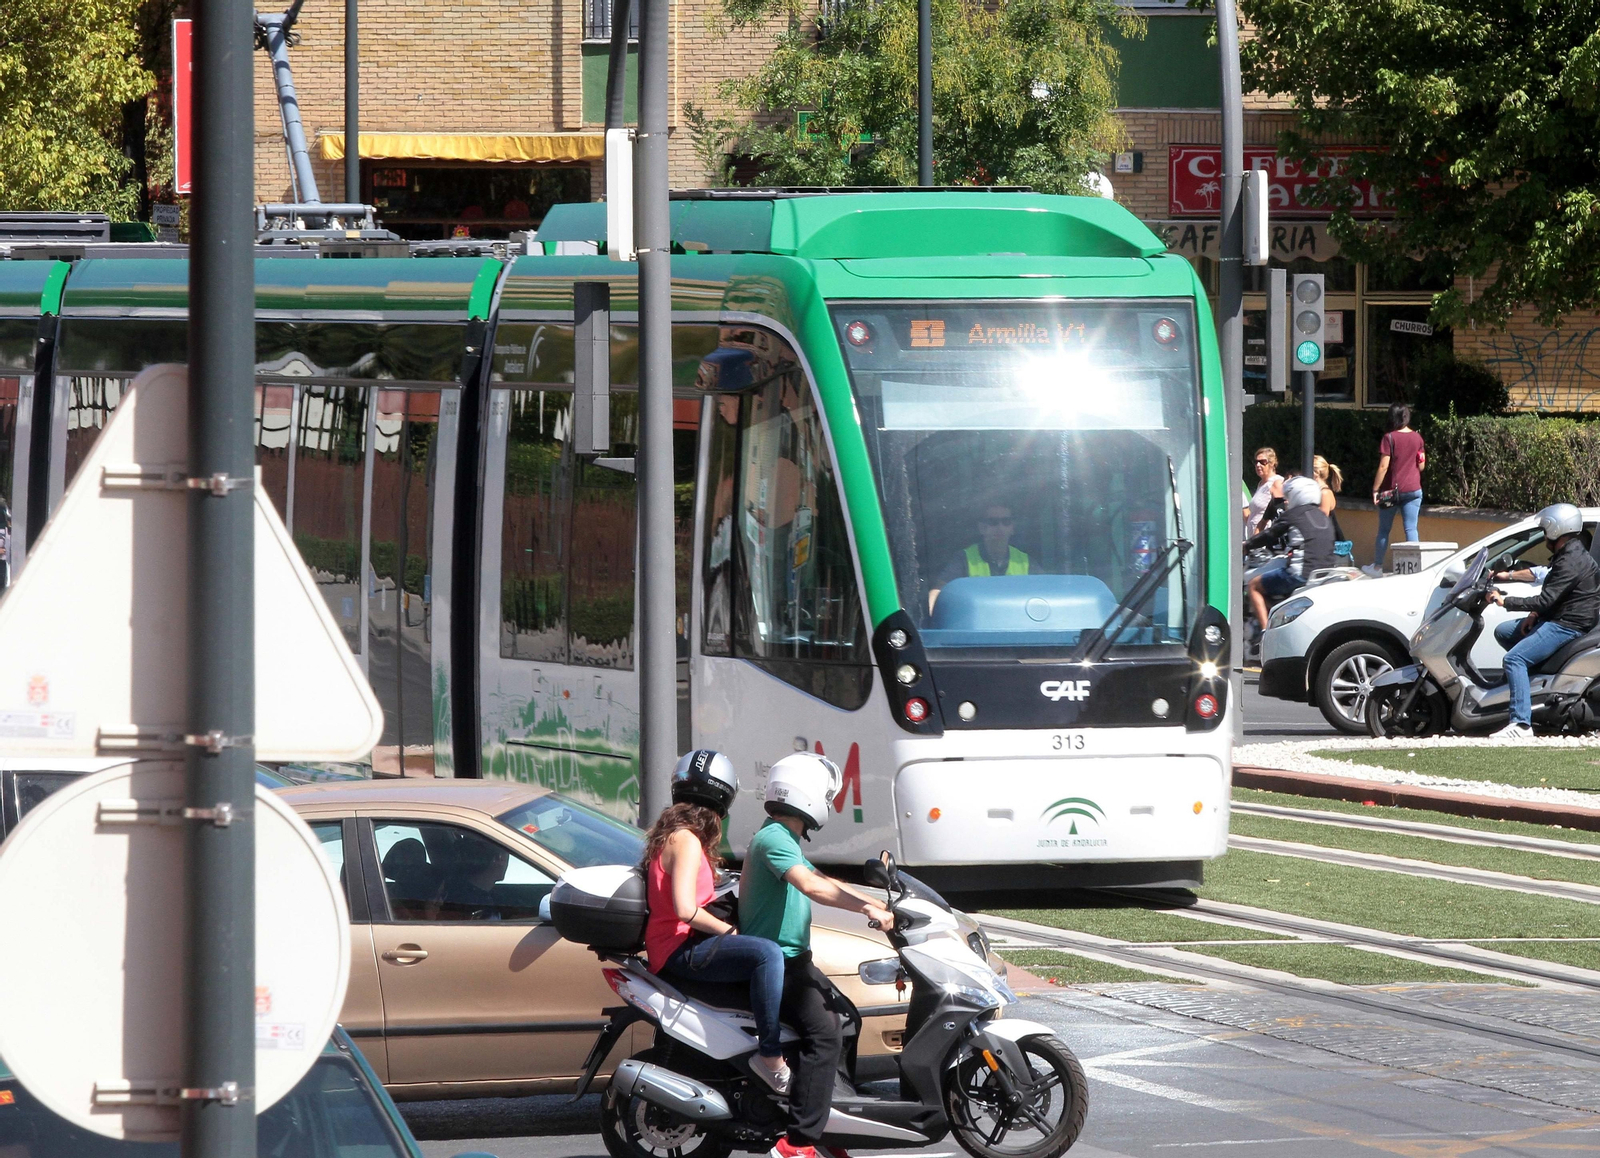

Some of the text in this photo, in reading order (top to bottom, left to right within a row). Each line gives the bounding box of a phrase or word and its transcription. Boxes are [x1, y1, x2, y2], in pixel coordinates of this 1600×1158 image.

[1163, 224, 1317, 254] CAFRIA
[968, 323, 1050, 344] Armilla
[1394, 321, 1433, 334] CHURROS
[1040, 680, 1091, 701] CAF
[1052, 734, 1085, 750] 313
[695, 750, 709, 773] JET
[1037, 839, 1058, 848] JUNTA
[1060, 839, 1069, 847] DE
